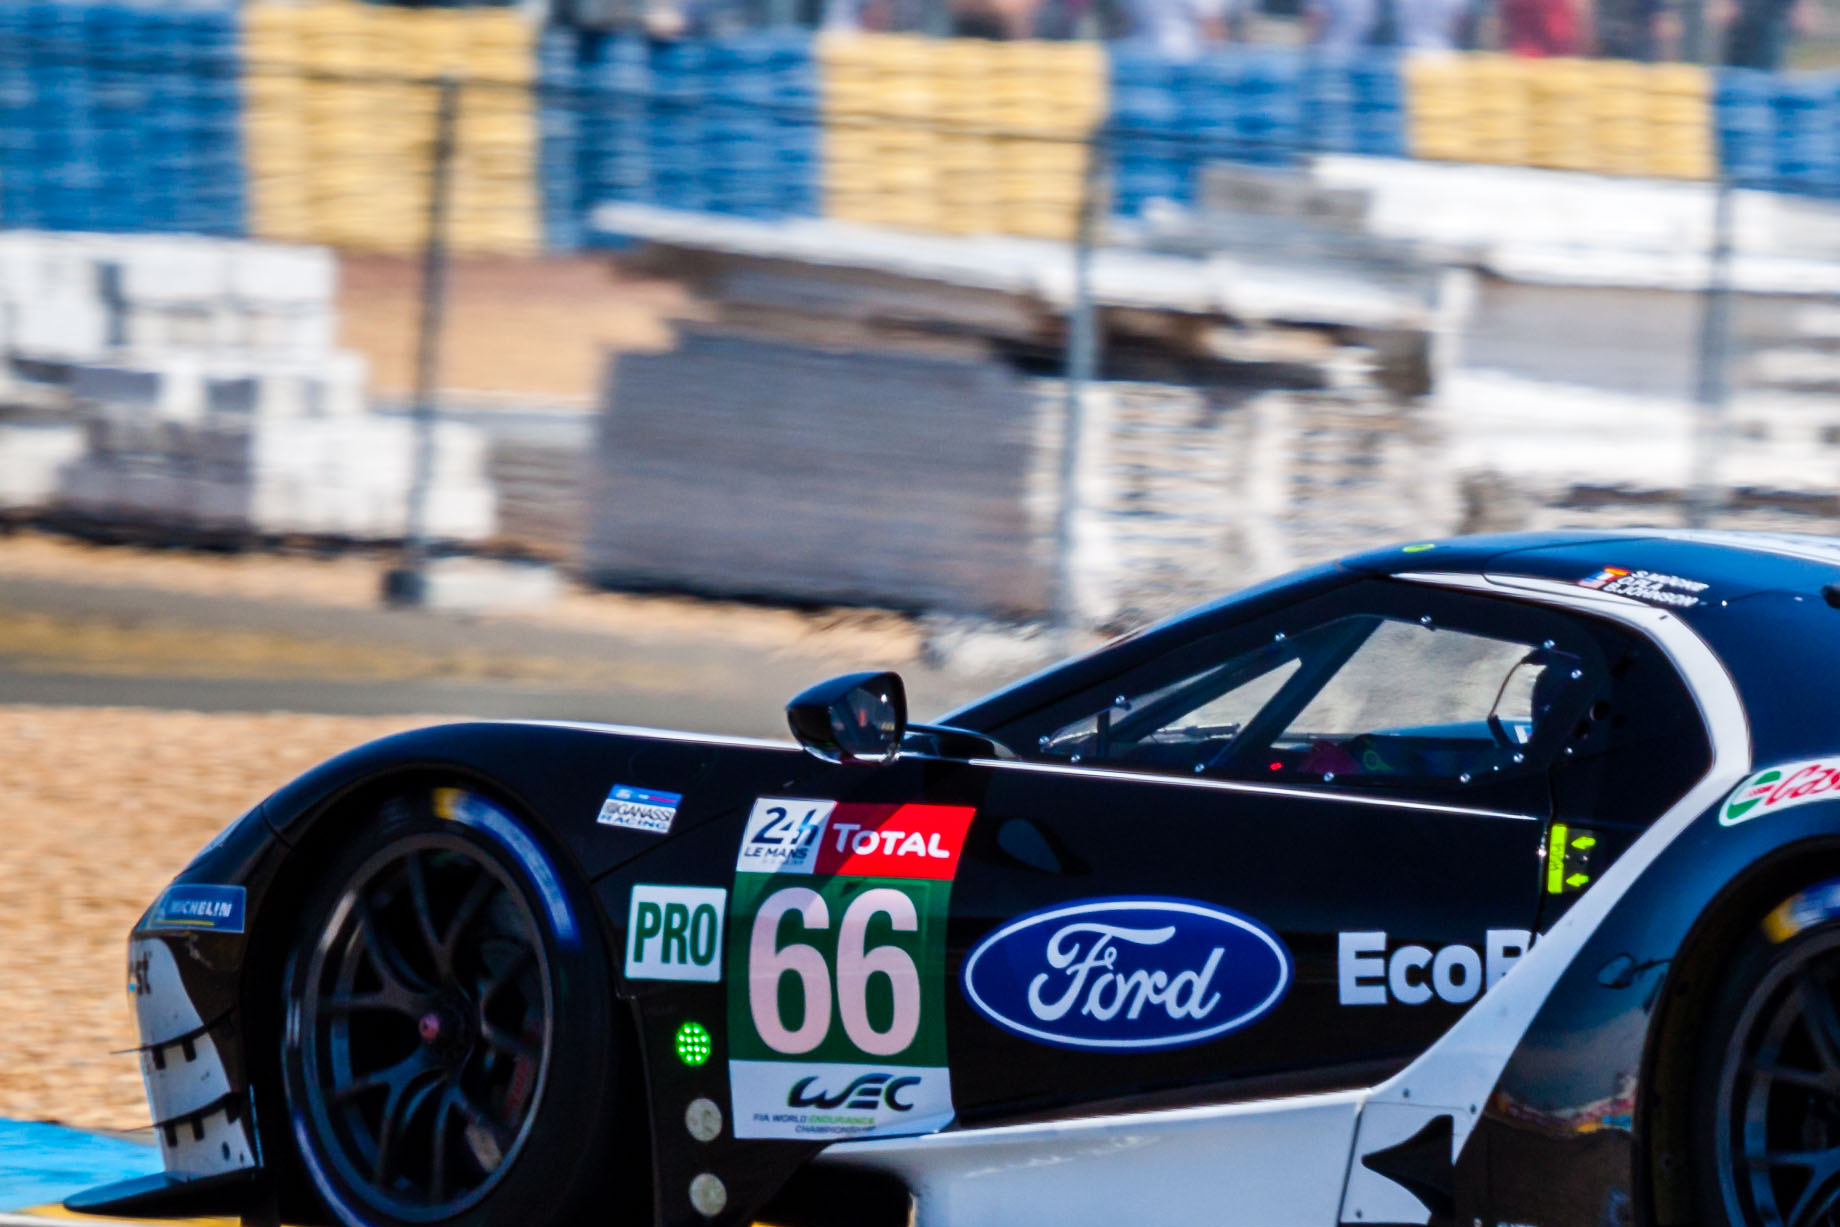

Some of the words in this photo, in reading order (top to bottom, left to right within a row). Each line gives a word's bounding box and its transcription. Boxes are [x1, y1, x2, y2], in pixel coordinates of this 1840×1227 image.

[743, 846, 766, 858] LE
[765, 847, 809, 860] MANS
[832, 822, 951, 859] TOTAL
[632, 900, 719, 967] PRO
[748, 886, 921, 1057] 66
[1027, 922, 1226, 1022] Ford
[786, 1071, 923, 1112] WEC
[772, 1113, 807, 1124] WORLD
[808, 1113, 876, 1125] ENDURANCE
